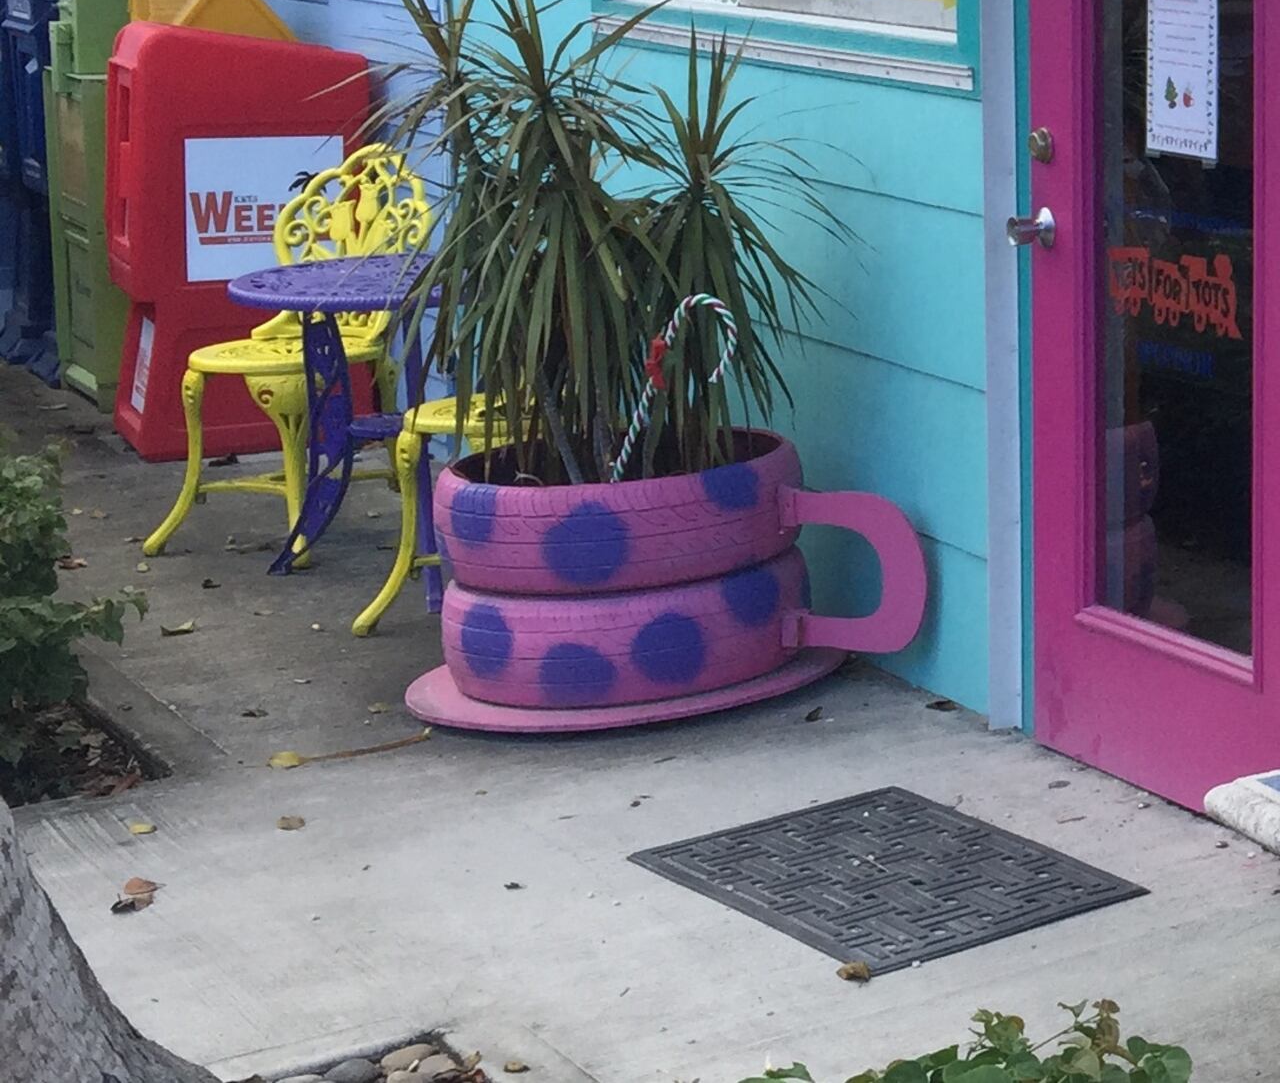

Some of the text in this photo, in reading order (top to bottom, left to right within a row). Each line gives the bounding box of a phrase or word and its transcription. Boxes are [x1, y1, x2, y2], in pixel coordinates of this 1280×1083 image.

[189, 190, 285, 234] WEE
[1153, 268, 1182, 305] FOR
[1191, 279, 1231, 319] TOTS
